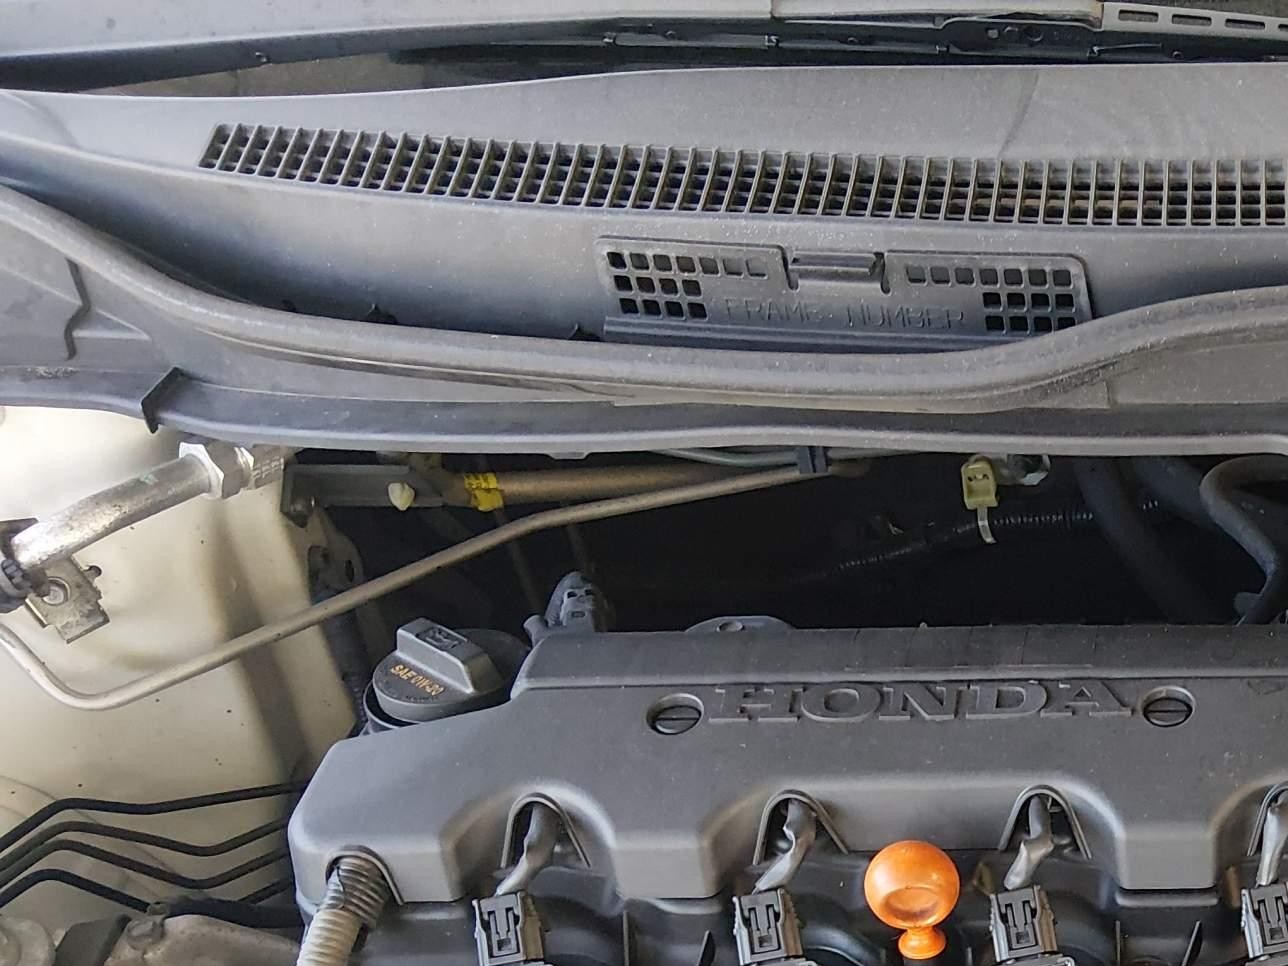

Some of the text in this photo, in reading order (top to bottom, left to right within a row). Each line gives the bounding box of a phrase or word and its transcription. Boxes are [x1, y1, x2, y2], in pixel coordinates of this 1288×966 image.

[724, 298, 965, 330] FRAME NUMBER
[391, 665, 418, 680] SAE
[708, 680, 1133, 723] HONDA
